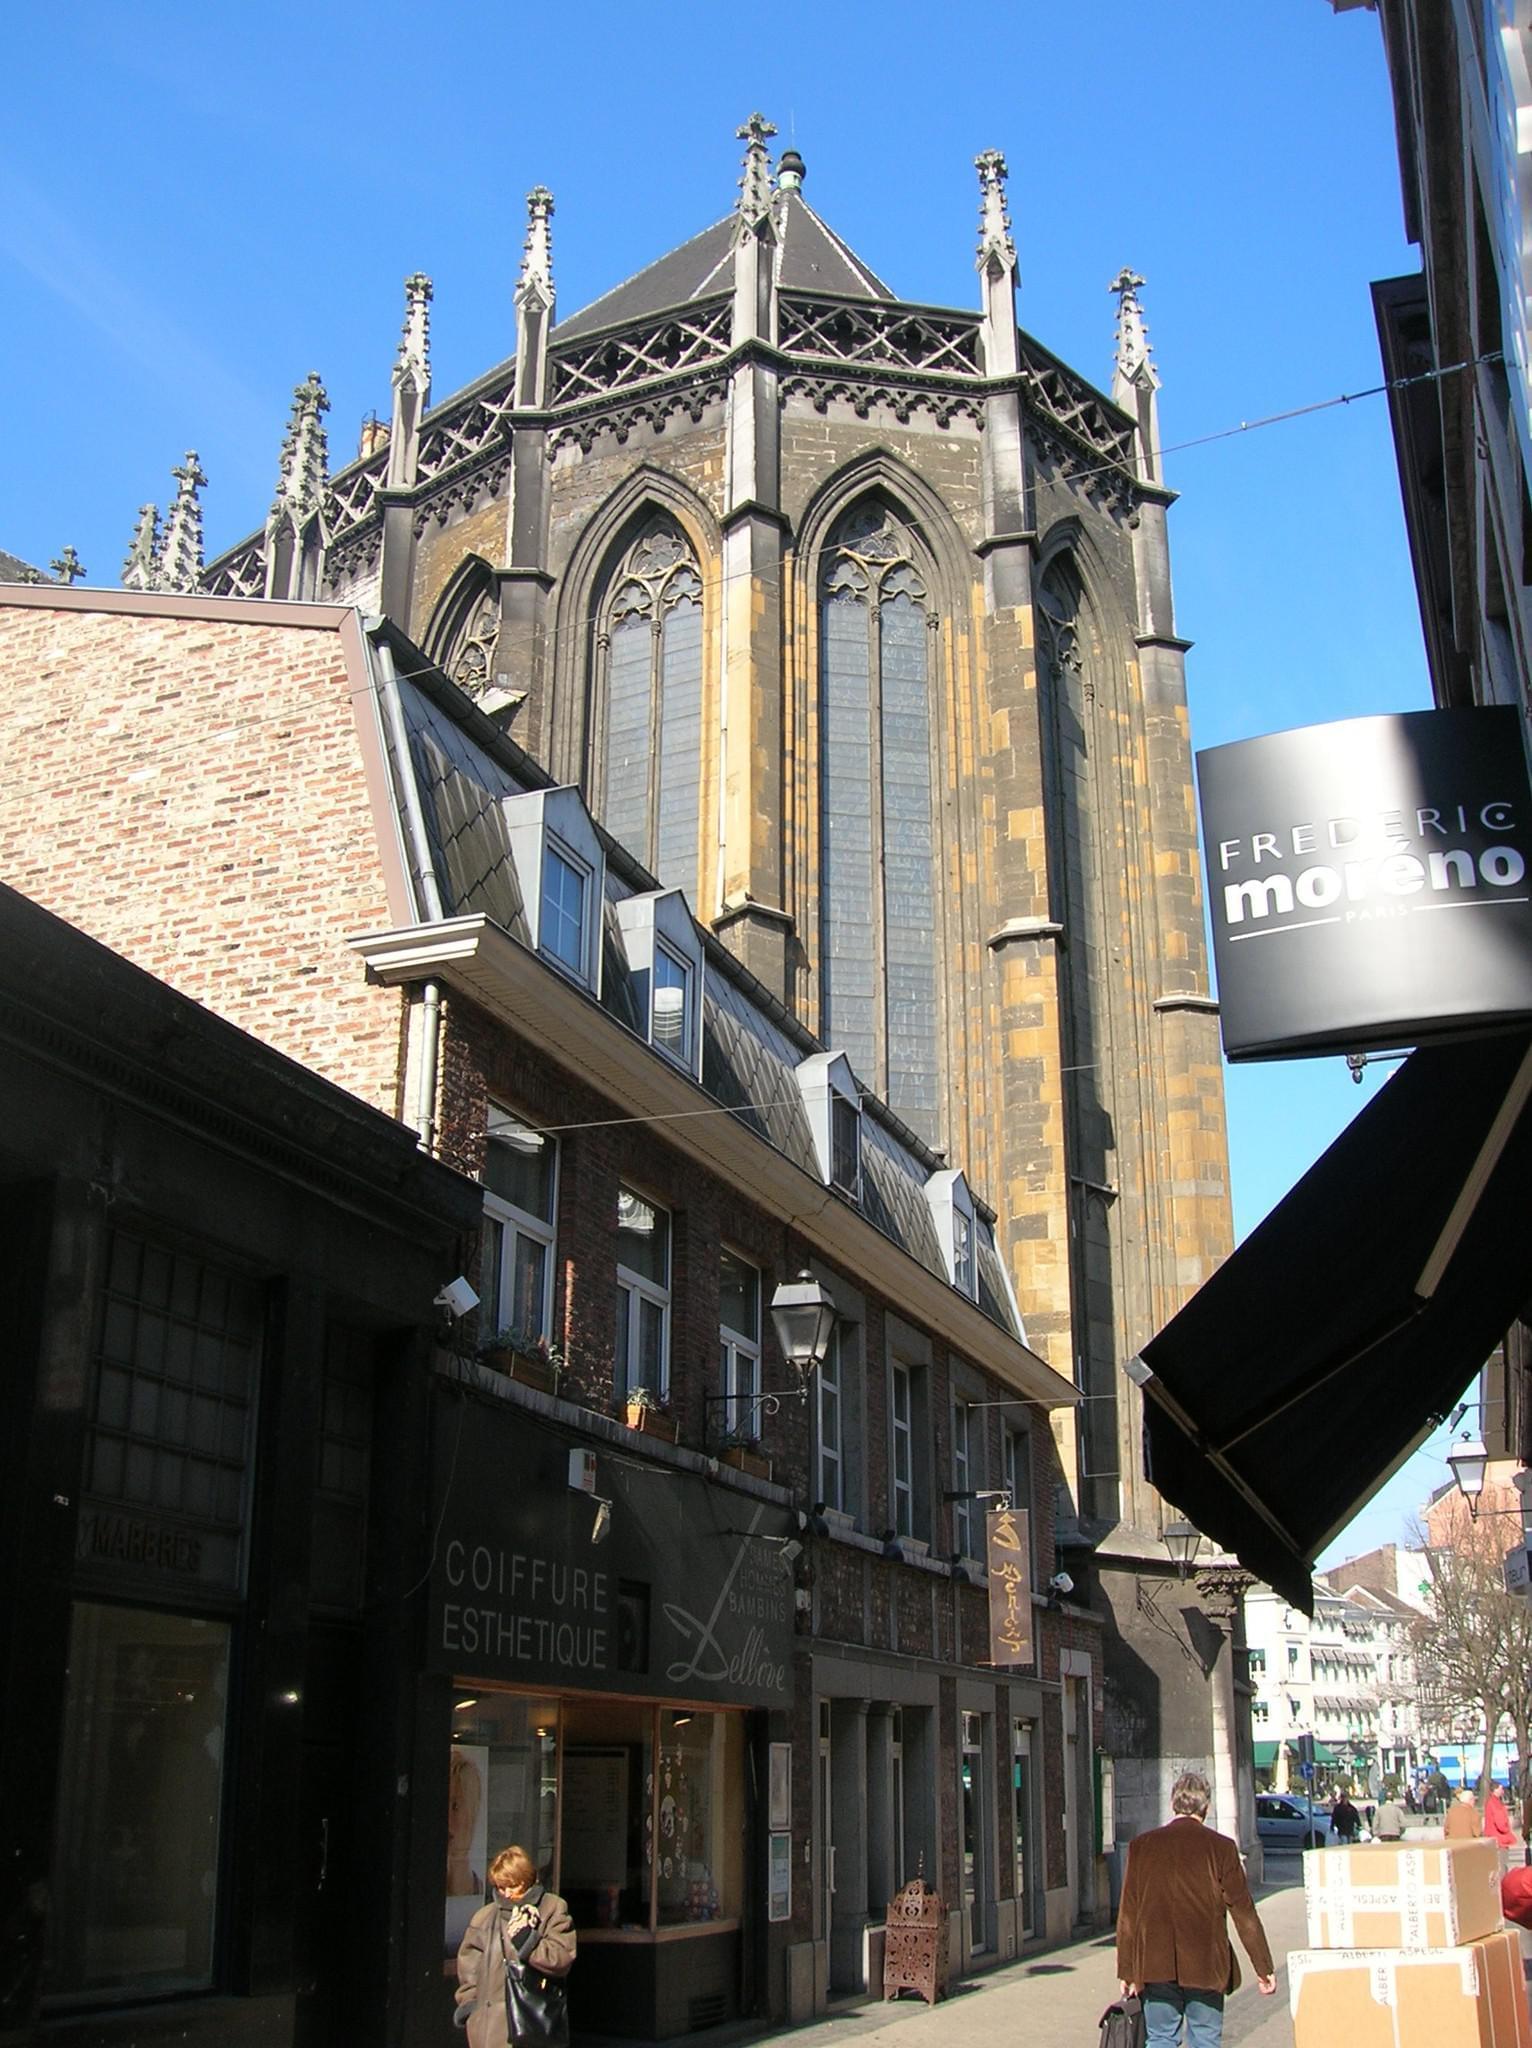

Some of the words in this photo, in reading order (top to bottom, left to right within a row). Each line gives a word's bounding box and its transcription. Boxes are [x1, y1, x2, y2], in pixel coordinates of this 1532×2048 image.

[1345, 904, 1408, 923] PARIS
[445, 1540, 607, 1614] COIFFURE
[729, 1591, 785, 1622] BAMBINS
[443, 1605, 606, 1670] ESTHETIQUE
